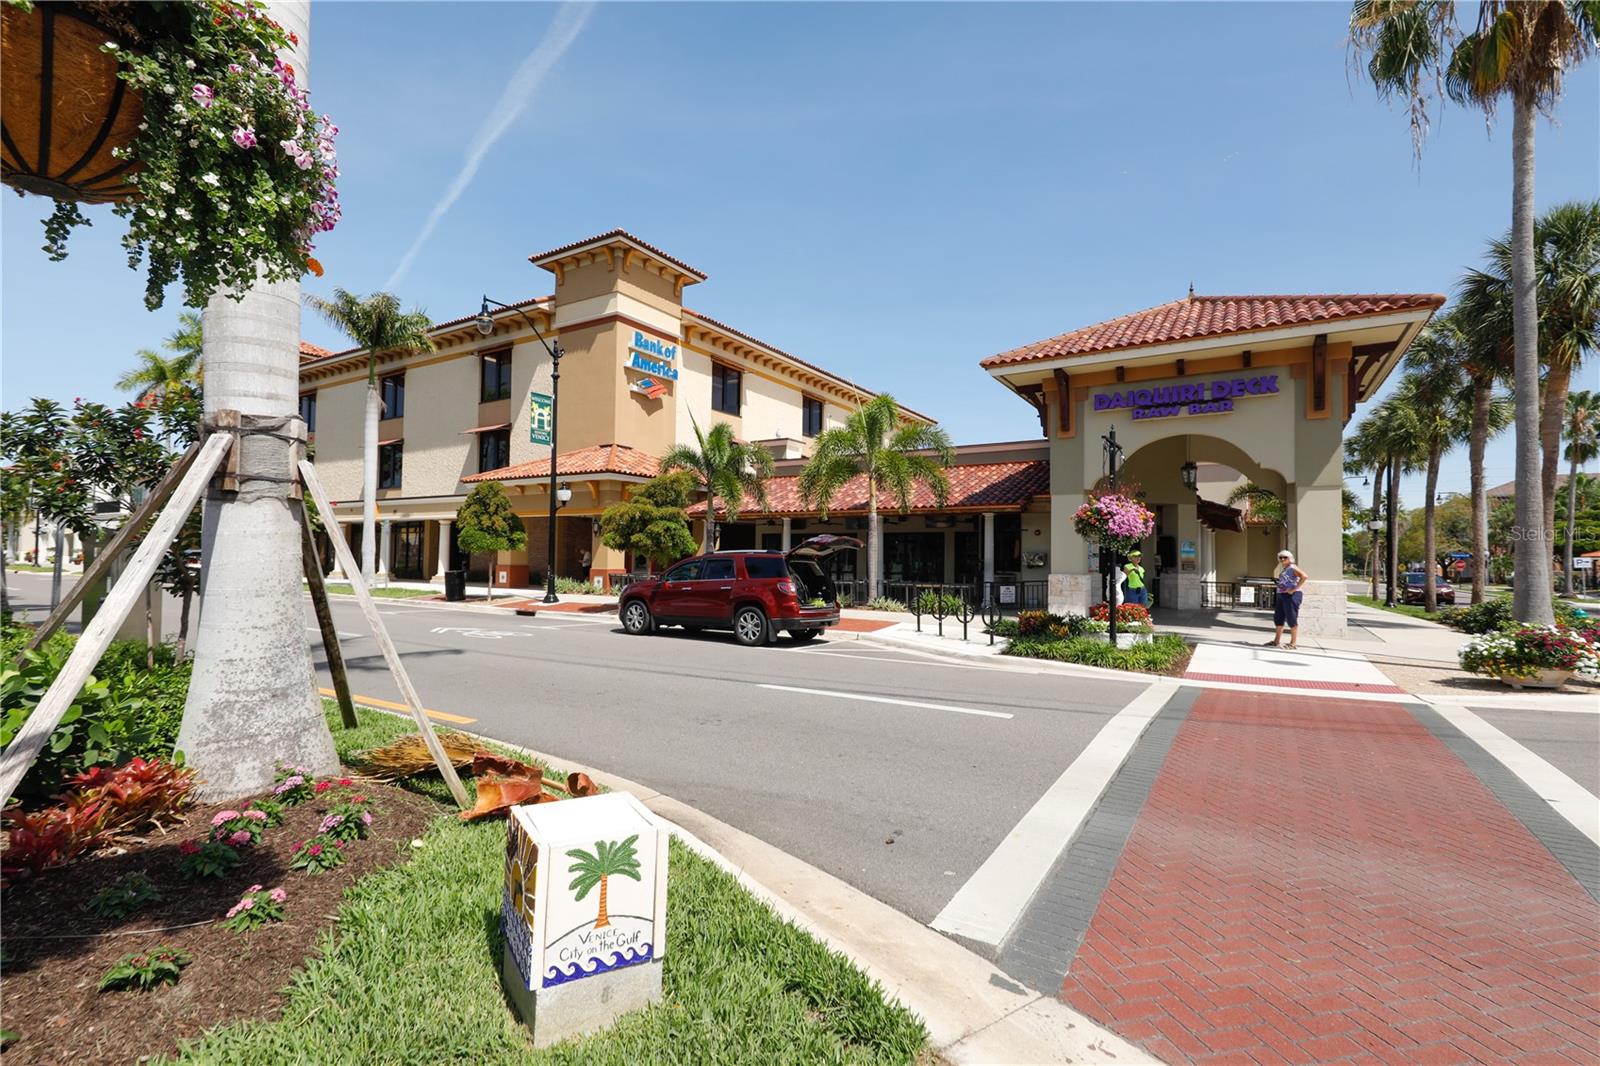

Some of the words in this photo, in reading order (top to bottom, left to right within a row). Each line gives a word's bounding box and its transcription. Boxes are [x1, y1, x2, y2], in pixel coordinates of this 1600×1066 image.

[633, 331, 663, 356] Bank
[664, 346, 677, 360] of
[631, 352, 679, 381] America
[1094, 383, 1205, 411] DAIQUIRI
[1211, 375, 1280, 398] DECK
[1131, 405, 1181, 420] RAW
[1188, 400, 1233, 415] BAR
[560, 947, 583, 961] City
[587, 946, 597, 955] on
[599, 939, 615, 952] the
[616, 930, 641, 947] Gulf
